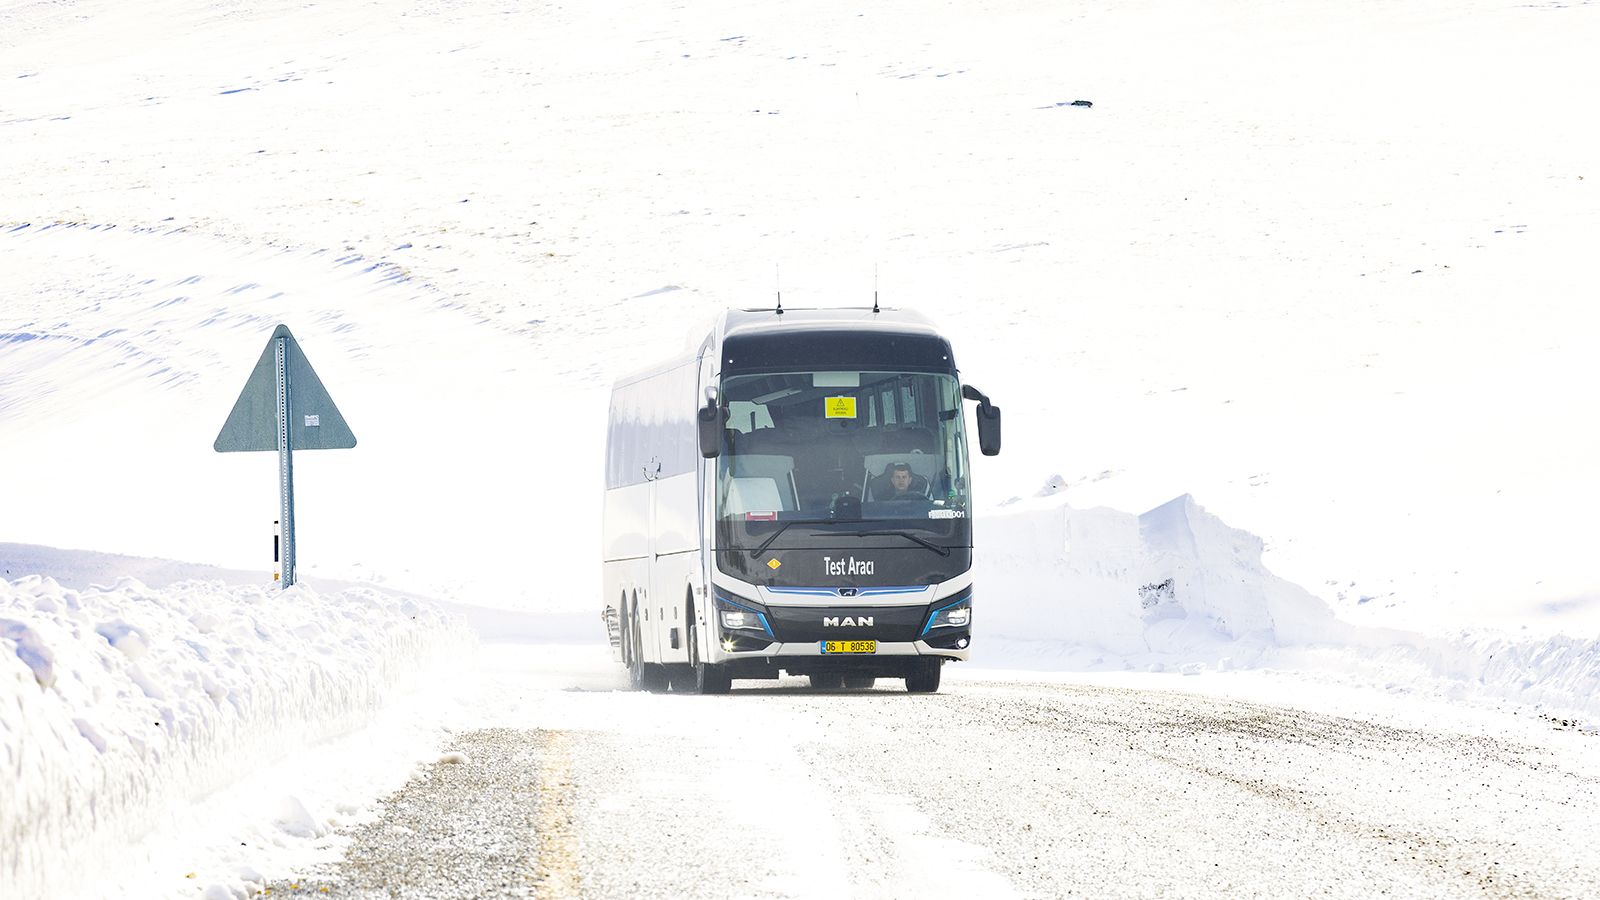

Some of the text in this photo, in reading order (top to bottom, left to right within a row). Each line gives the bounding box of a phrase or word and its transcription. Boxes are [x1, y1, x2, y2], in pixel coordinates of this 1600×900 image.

[823, 556, 874, 575] Test Aracı
[823, 616, 874, 627] MAN
[826, 642, 875, 651] 06 T 80536
